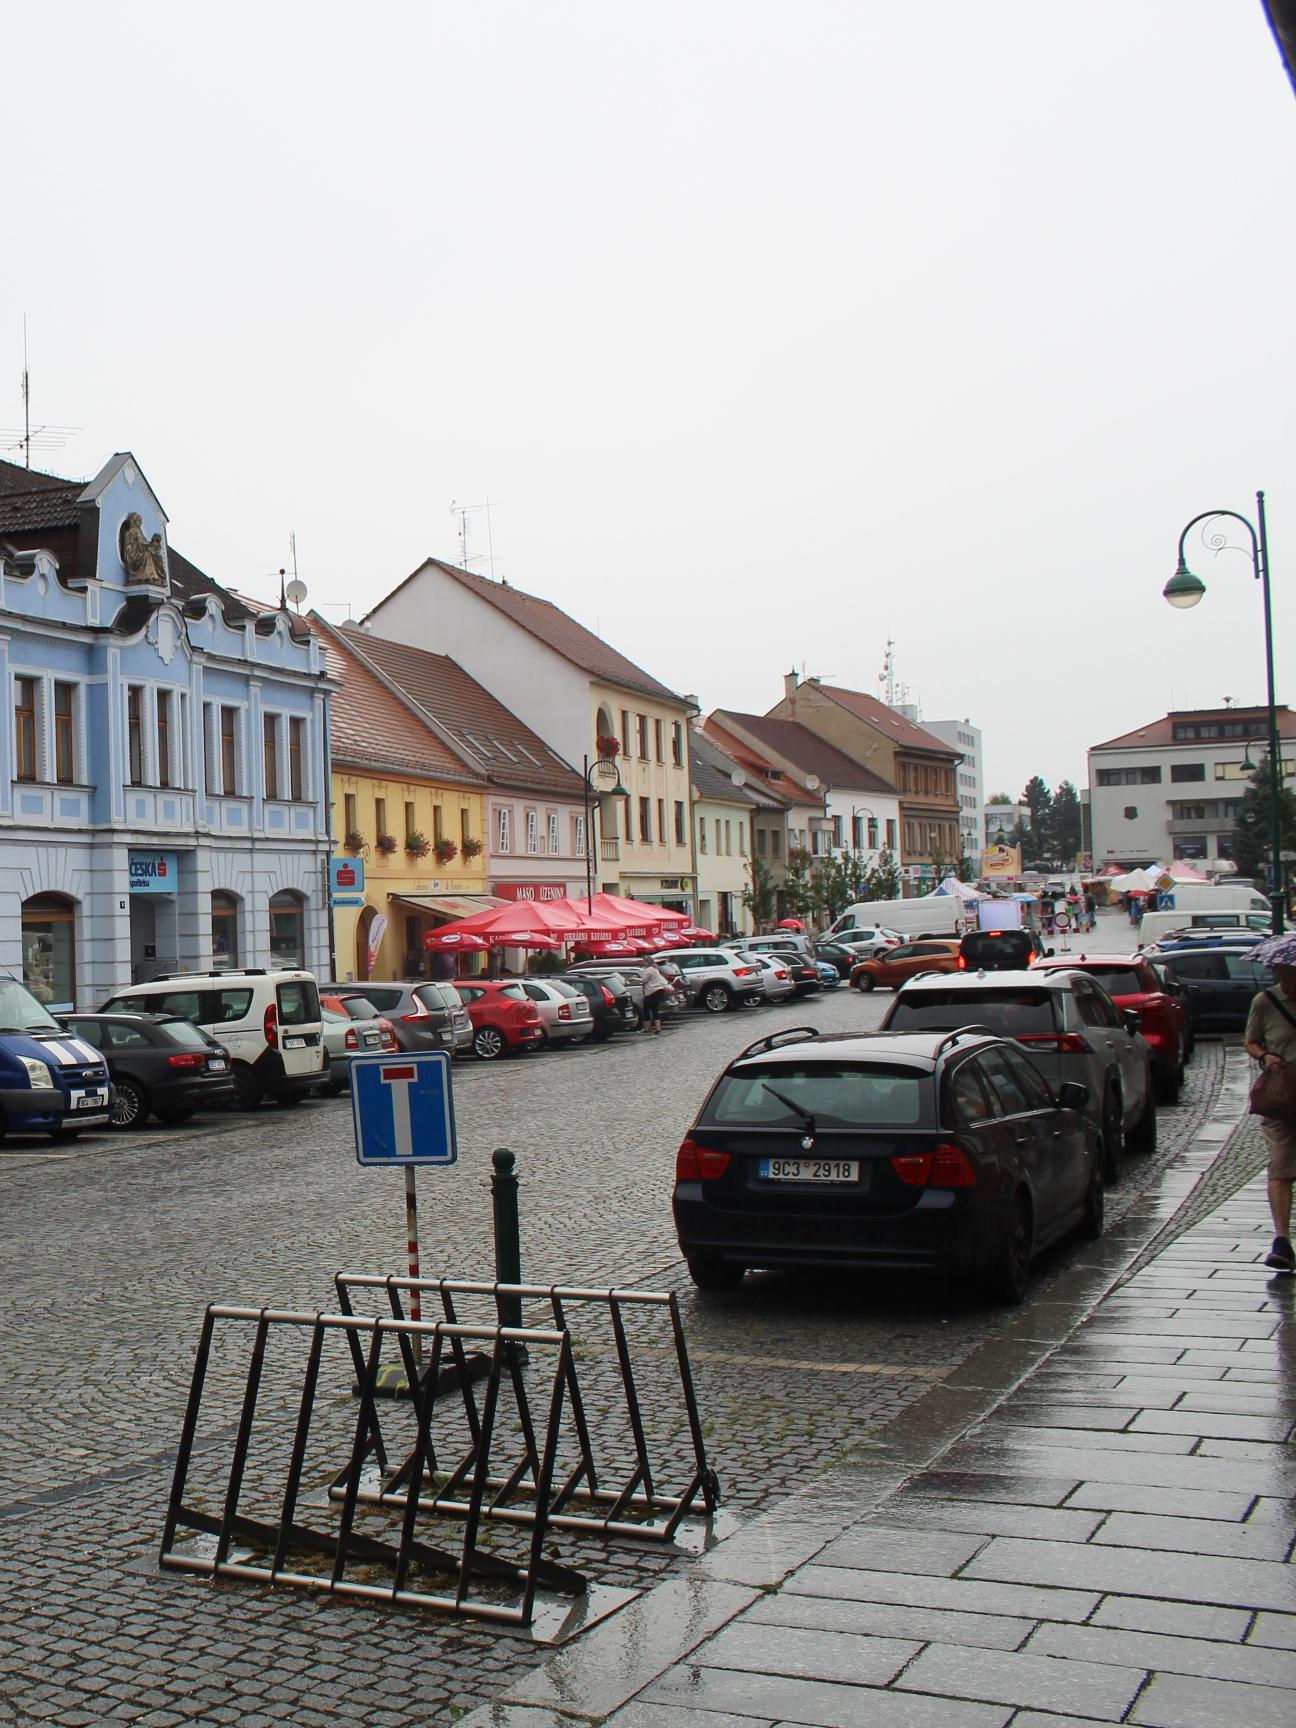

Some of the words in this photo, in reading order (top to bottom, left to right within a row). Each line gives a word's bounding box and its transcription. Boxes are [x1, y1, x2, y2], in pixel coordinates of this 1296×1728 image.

[129, 857, 157, 877] ČESKÁ
[516, 887, 535, 900] MASO
[539, 887, 564, 901] UZENINY
[772, 1161, 800, 1177] 9C3
[812, 1162, 851, 1178] 2918
